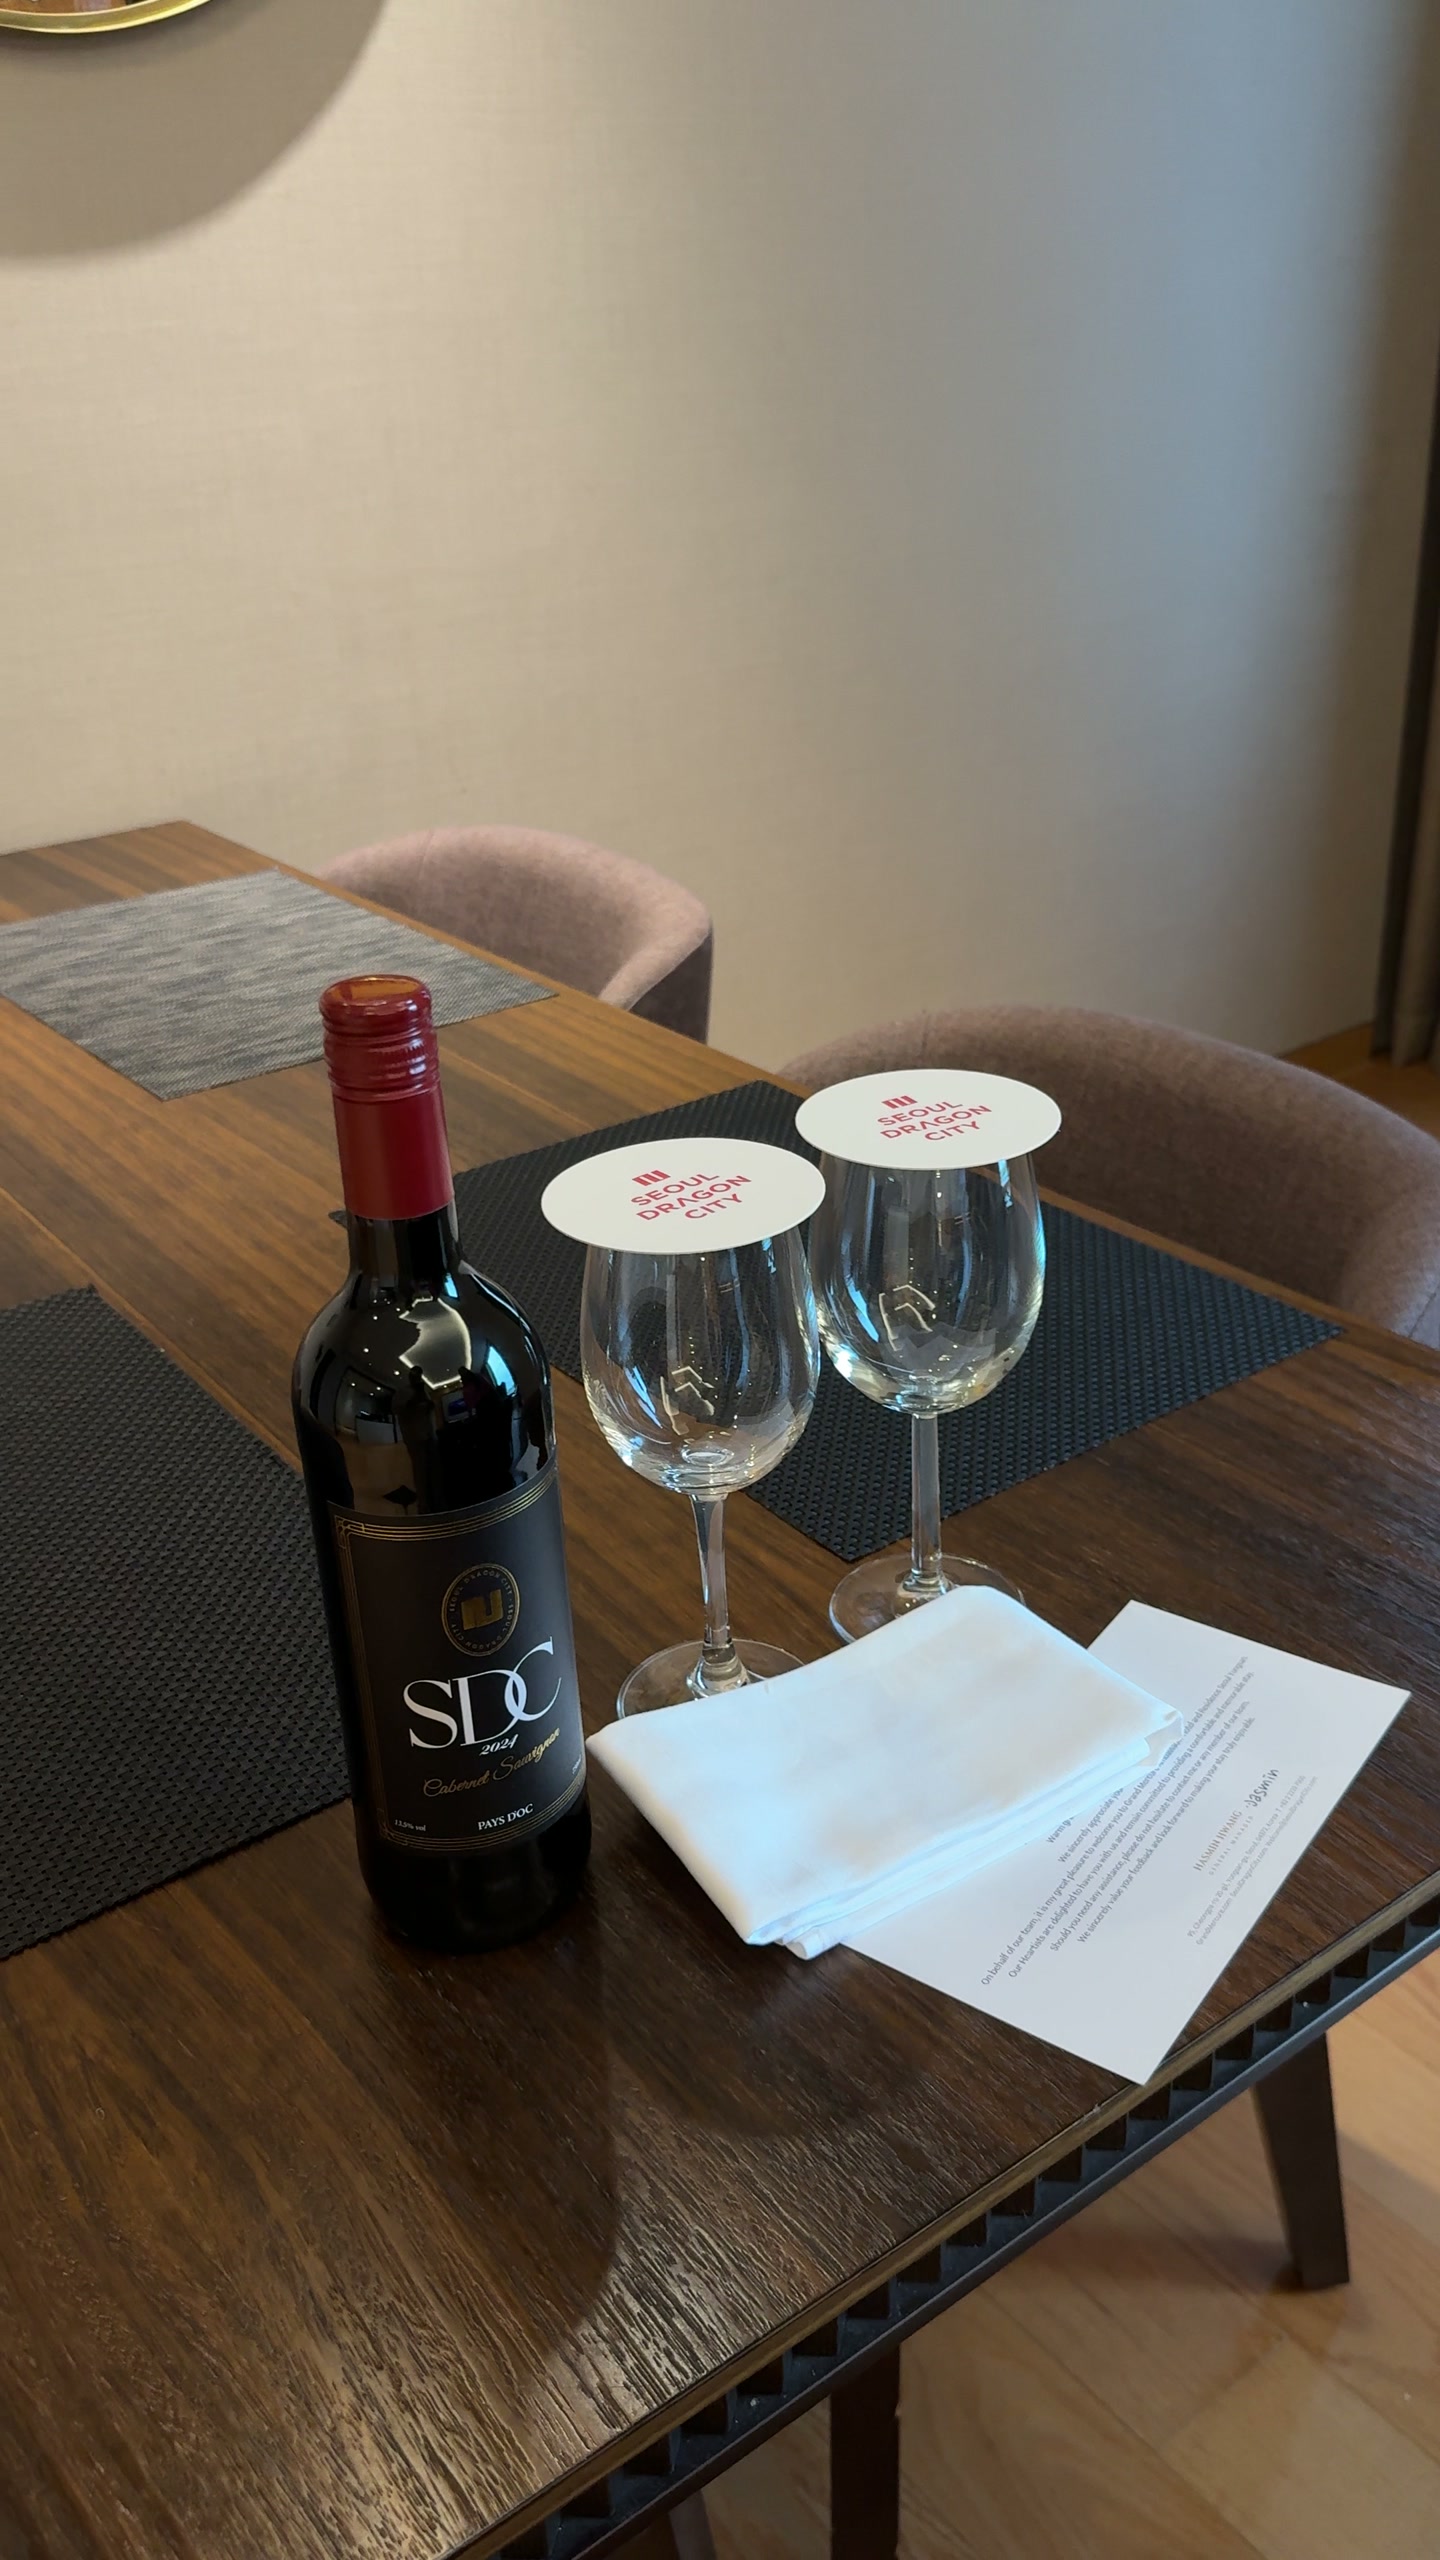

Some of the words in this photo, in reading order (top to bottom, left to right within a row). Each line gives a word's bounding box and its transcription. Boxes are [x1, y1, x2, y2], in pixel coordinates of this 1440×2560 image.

[877, 1101, 963, 1126] SEOUL
[880, 1105, 992, 1139] DRAGON
[925, 1120, 980, 1141] CITY
[631, 1174, 720, 1206] SEOUL
[636, 1175, 752, 1221] DRAGON
[685, 1193, 742, 1219] CITY
[403, 1636, 562, 1749] SDC
[479, 1733, 519, 1756] 2024
[423, 1770, 490, 1797] Cabernet
[492, 1727, 560, 1781] Sauvignon
[1161, 1776, 1172, 1784] to
[1124, 1786, 1143, 1807] Grand
[1111, 1811, 1124, 1825] you
[1118, 1805, 1129, 1813] to
[477, 1815, 505, 1831] PAYS
[1123, 1811, 1144, 1833] remain
[1091, 1822, 1115, 1849] welcome
[1115, 1829, 1128, 1844] and
[1058, 1851, 1072, 1863] We
[1067, 1827, 1093, 1854] sincerely
[1084, 1846, 1096, 1855] to
[1109, 1842, 1120, 1851] us
[1099, 1849, 1114, 1864] with
[1050, 1927, 1072, 1952] Should
[1068, 1916, 1082, 1931] you
[1077, 1899, 1094, 1919] need
[1090, 1889, 1103, 1903] any
[1122, 1841, 1140, 1863] please
[1135, 1833, 1146, 1843] do
[1142, 1822, 1155, 1835] not
[1165, 1795, 1176, 1803] to
[1067, 1853, 1090, 1882] pleasure
[1077, 1930, 1091, 1943] We
[1087, 1903, 1113, 1933] sincerely
[1108, 1887, 1124, 1905] value
[1120, 1873, 1134, 1890] your
[1128, 1847, 1155, 1875] feedback
[1151, 1834, 1164, 1849] and
[1184, 1795, 1195, 1804] to
[1090, 1862, 1104, 1876] you
[1053, 1878, 1071, 1897] great
[1076, 1873, 1095, 1890] have
[1072, 1887, 1083, 1896] to
[1038, 1905, 1049, 1913] is
[1045, 1895, 1058, 1907] my
[1050, 1893, 1078, 1925] delighted
[1033, 1910, 1045, 1918] it
[1043, 1923, 1055, 1937] are
[1007, 1944, 1016, 1955] of
[1013, 1934, 1025, 1948] our
[987, 1952, 1010, 1976] behalf
[1008, 1963, 1023, 1978] Our
[981, 1974, 995, 1985] On
